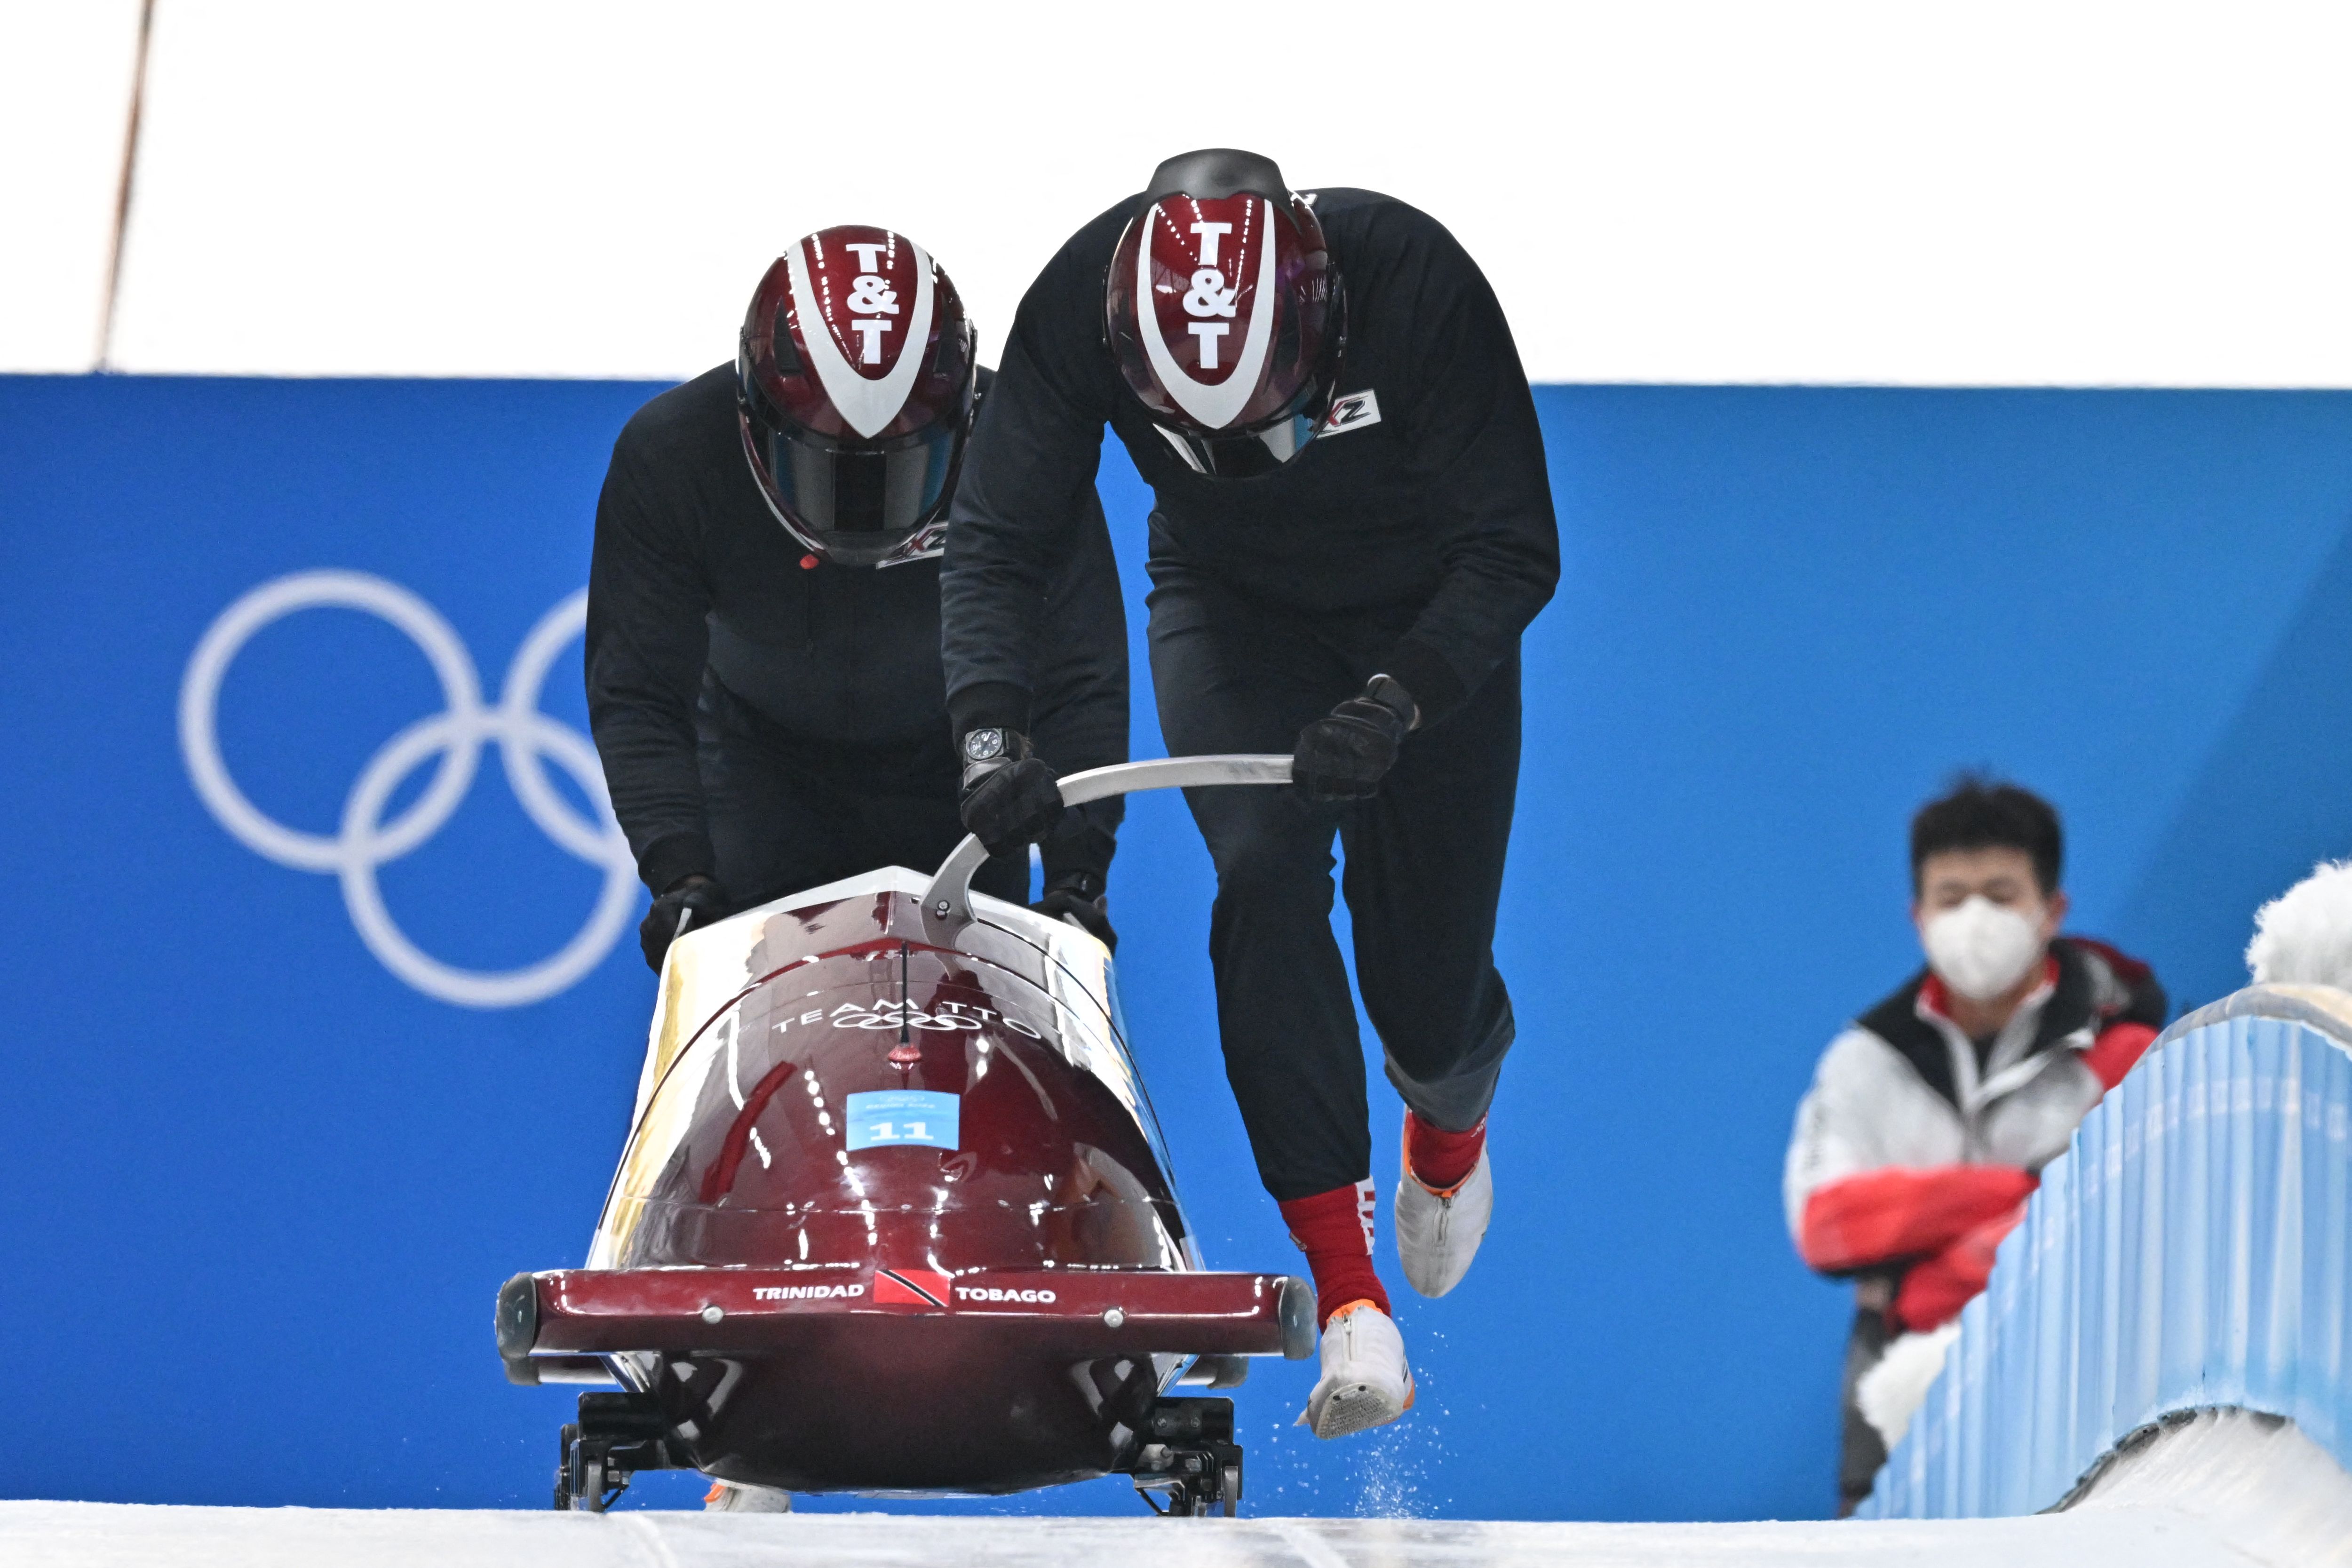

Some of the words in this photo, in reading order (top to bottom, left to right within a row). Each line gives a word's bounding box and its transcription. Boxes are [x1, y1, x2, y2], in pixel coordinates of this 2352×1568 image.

[845, 243, 899, 365] T&T
[1182, 222, 1238, 369] T&T
[772, 998, 919, 1034] TEAM
[942, 1001, 1041, 1039] TTO
[869, 1122, 934, 1141] 11
[753, 1284, 864, 1300] TRINIDAD
[955, 1287, 1057, 1304] TOBAGO
